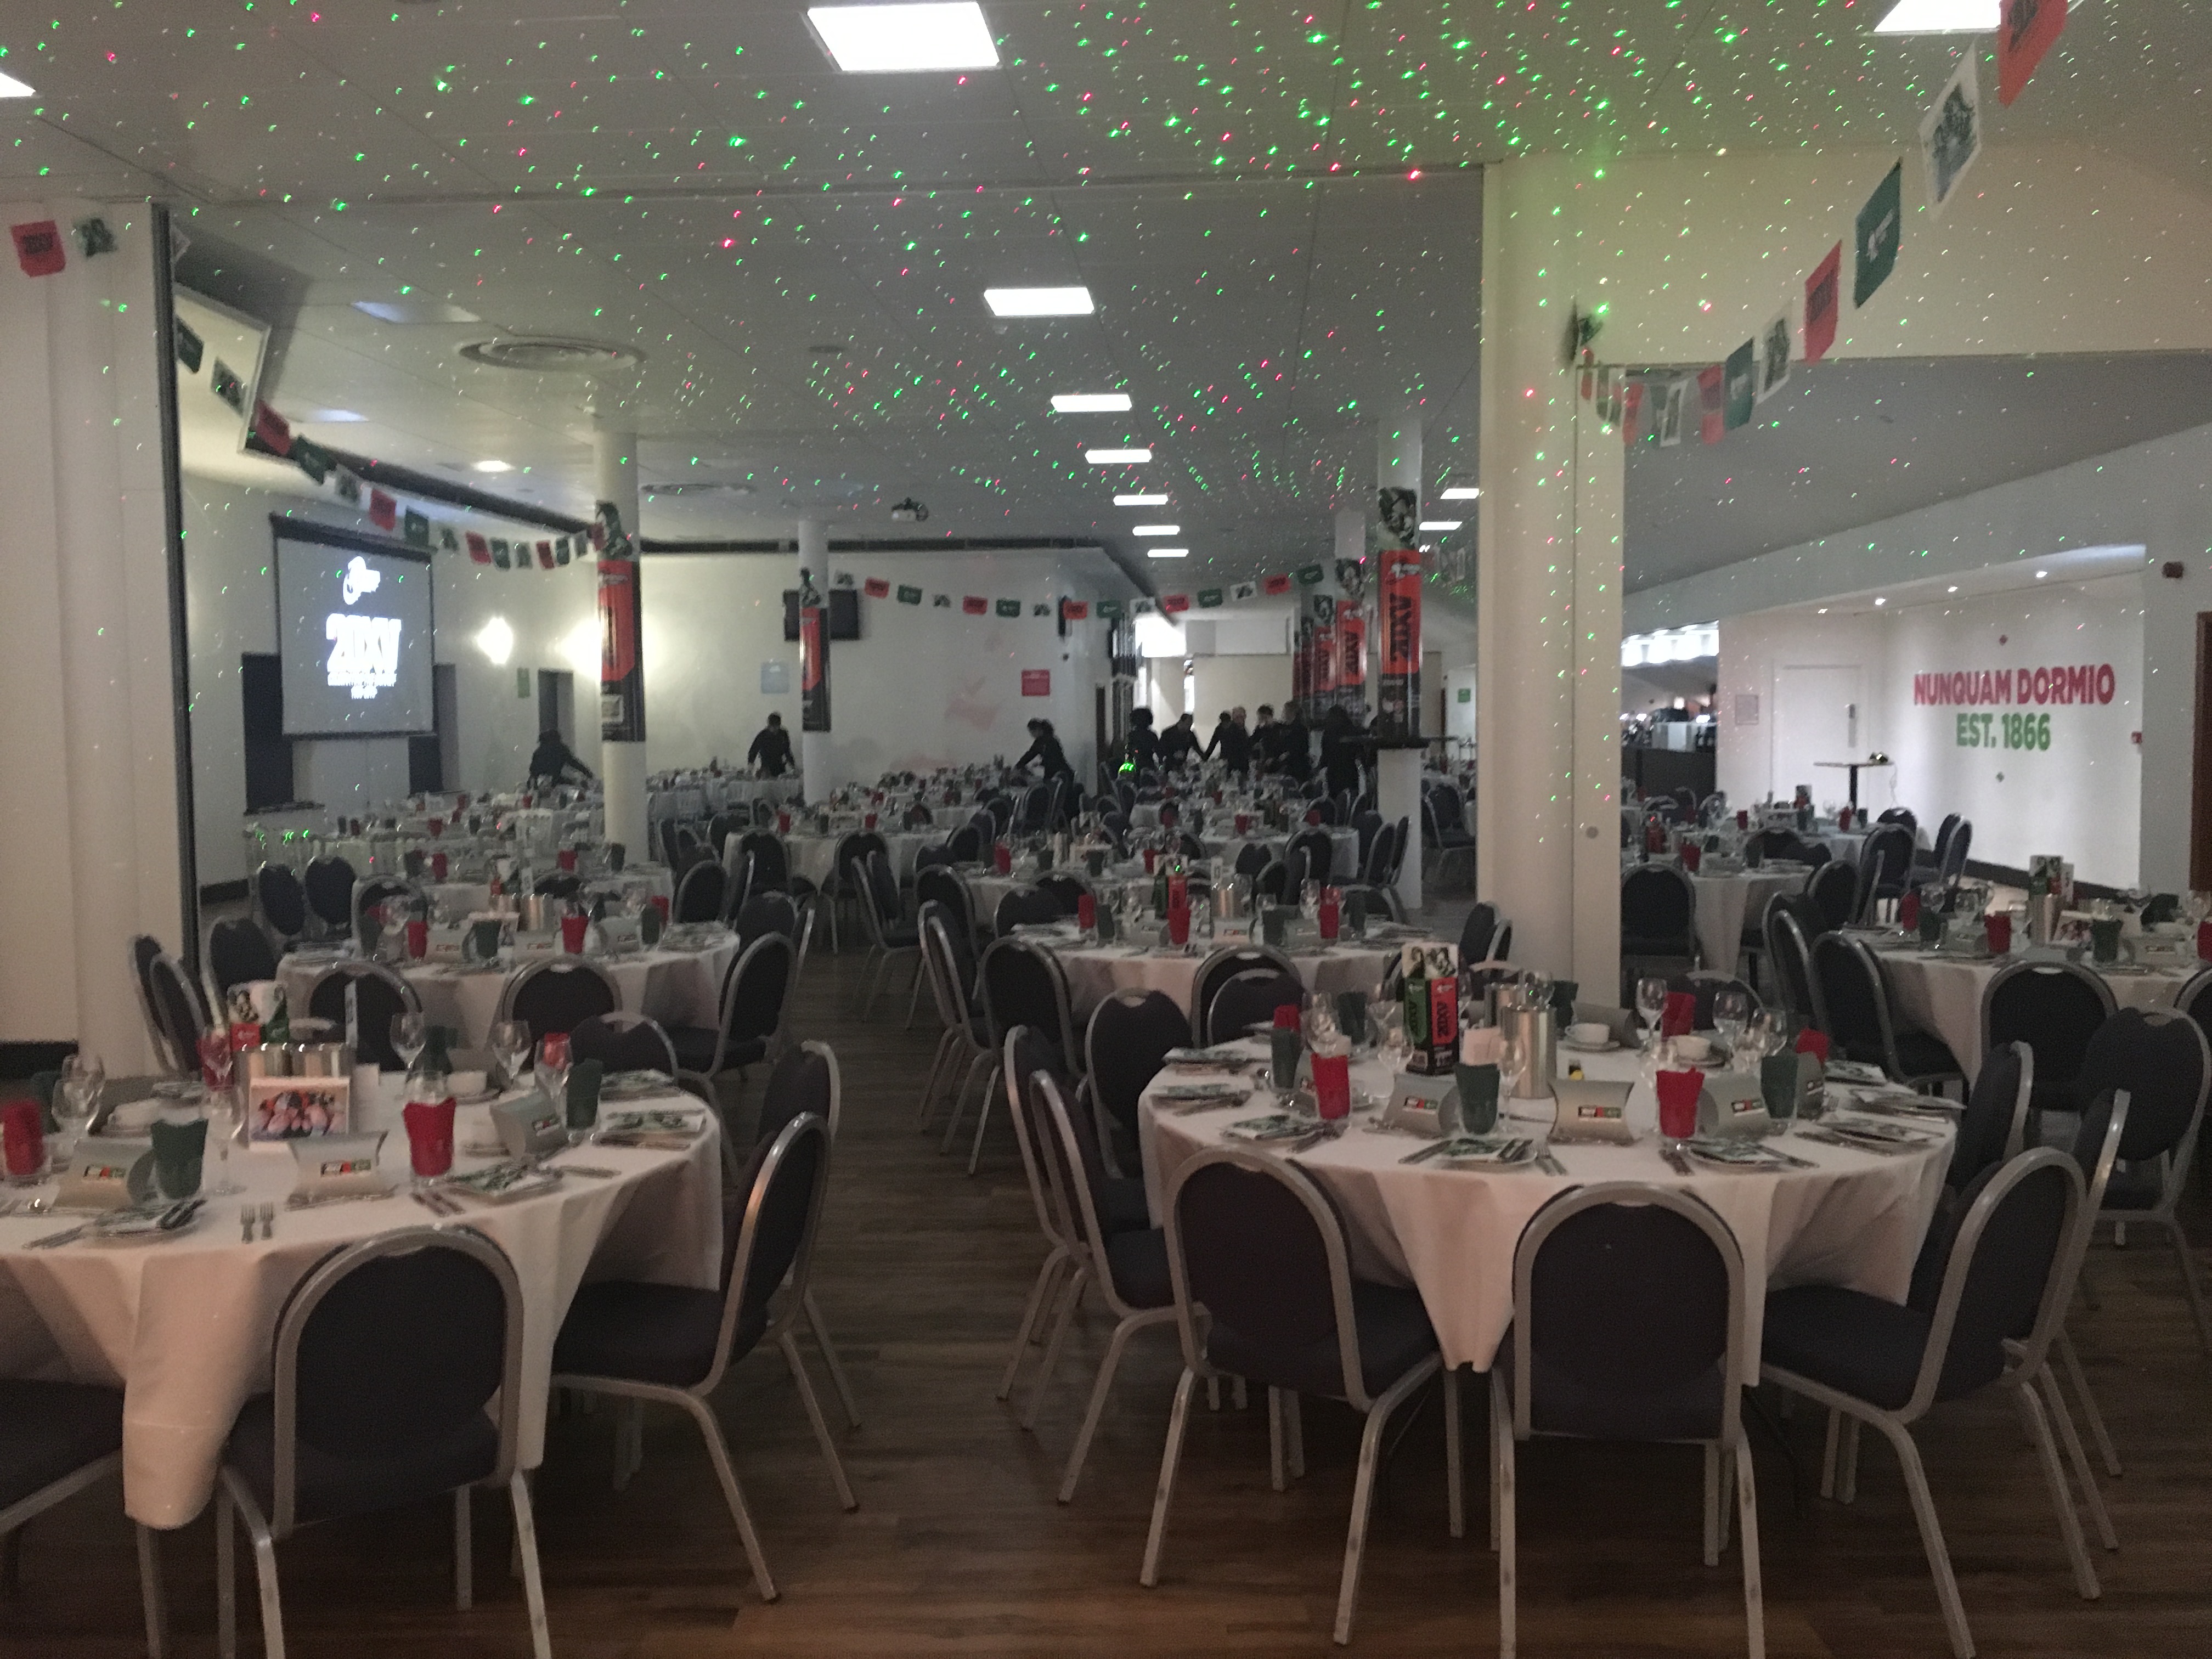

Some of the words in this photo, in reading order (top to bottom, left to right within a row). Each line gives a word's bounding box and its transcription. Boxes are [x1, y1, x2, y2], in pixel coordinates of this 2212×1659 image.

[1914, 669, 2012, 706] NUNQUAM
[2017, 663, 2115, 705] DORMIO
[1956, 713, 1996, 748] EST.
[2001, 713, 2051, 751] 1866
